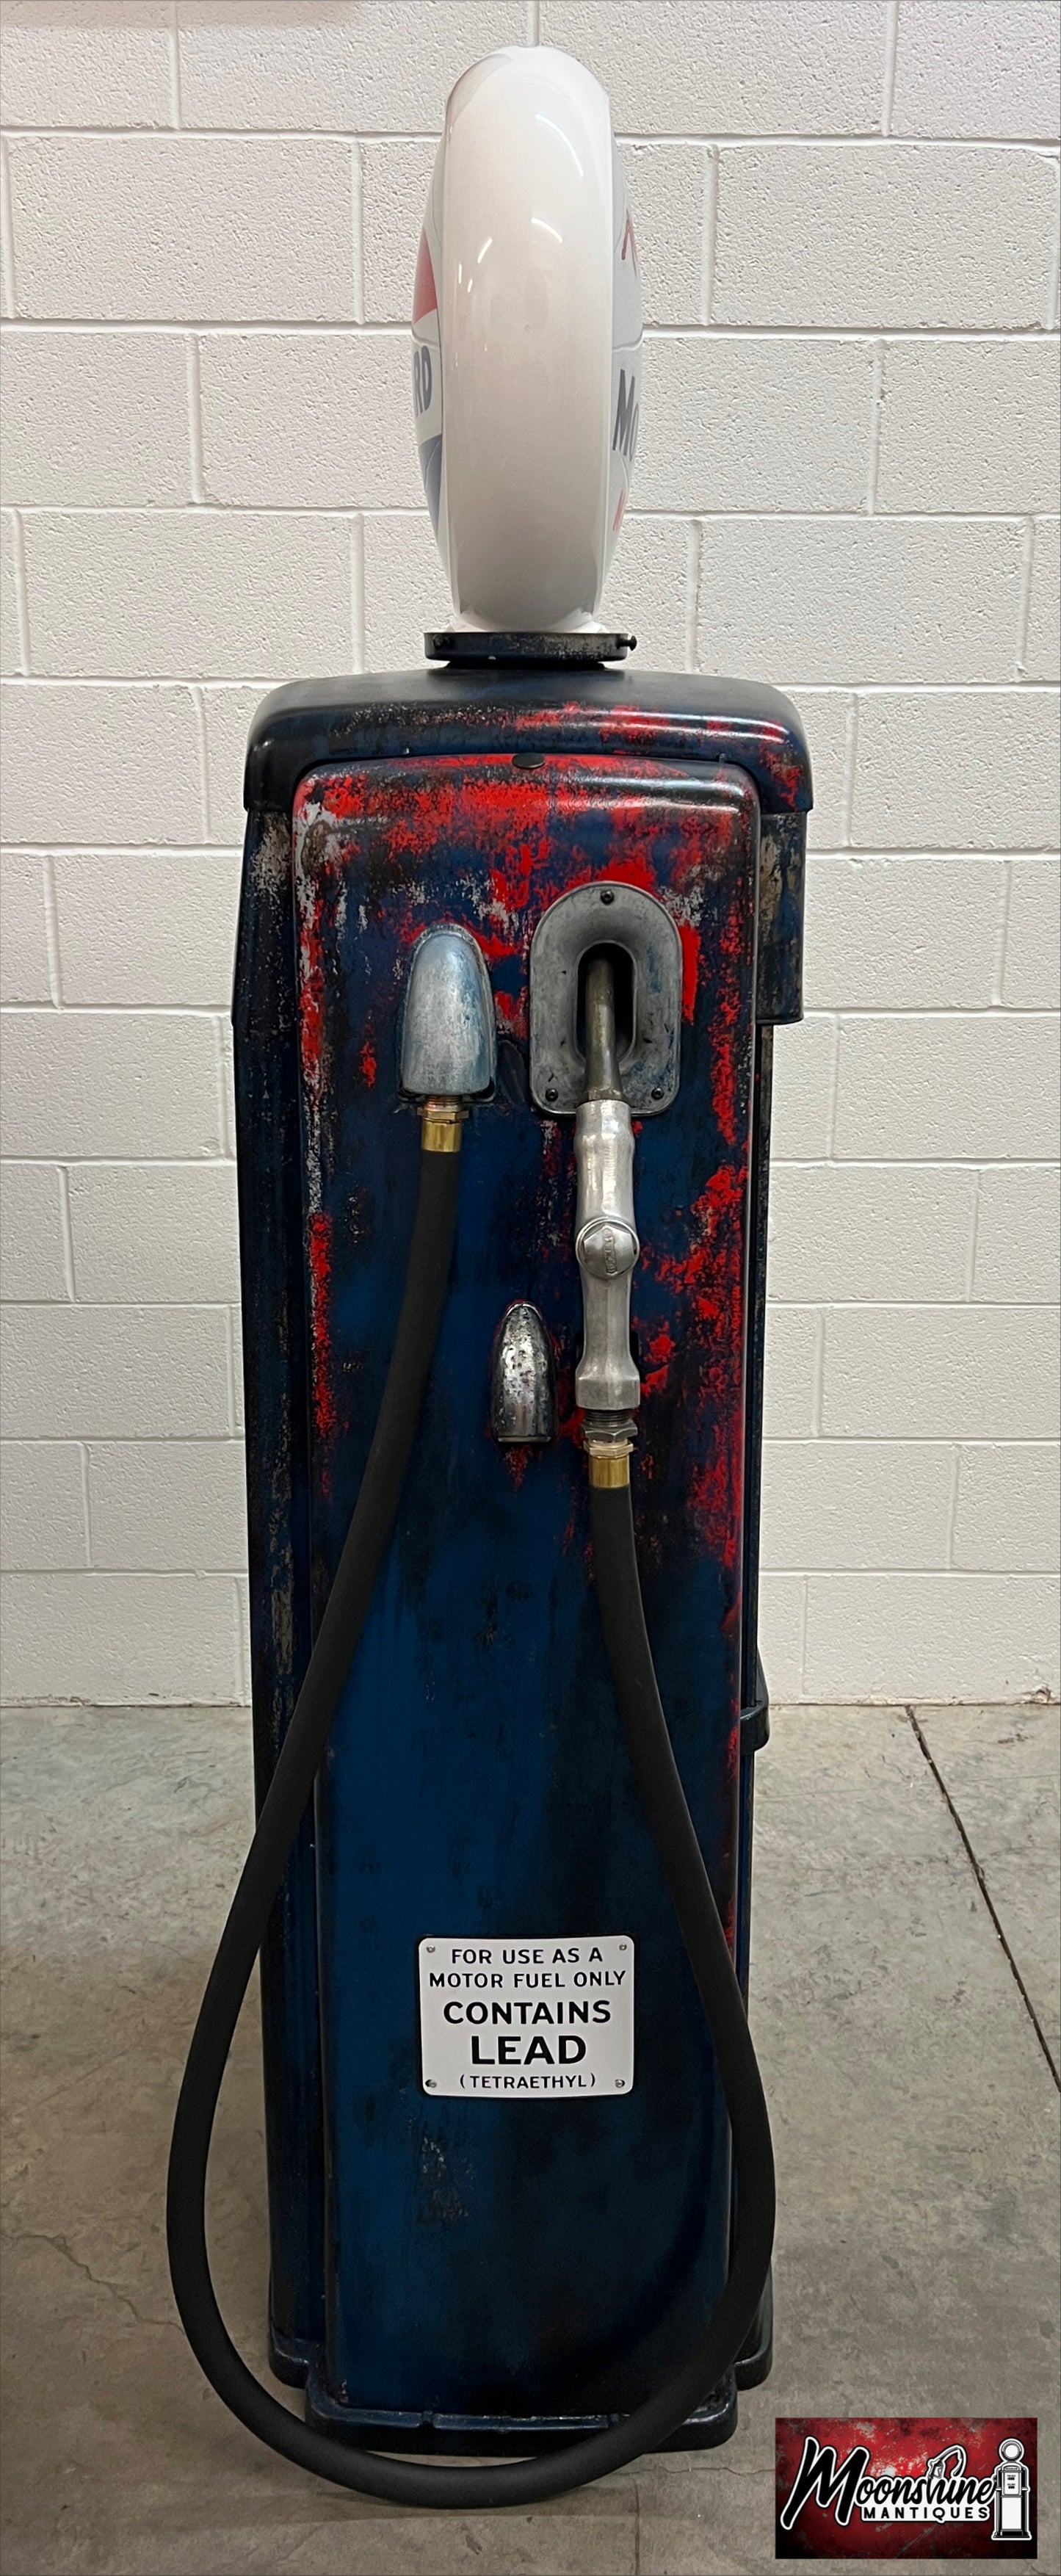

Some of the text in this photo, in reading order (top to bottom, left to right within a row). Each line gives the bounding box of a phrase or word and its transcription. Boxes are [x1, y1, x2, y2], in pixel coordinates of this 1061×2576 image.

[452, 1947, 602, 1964] FOR USE AS A
[430, 1970, 626, 1988] MOTOR FUEL ONLY
[443, 2000, 610, 2024] CONTAINS
[471, 2036, 586, 2064] LEAD
